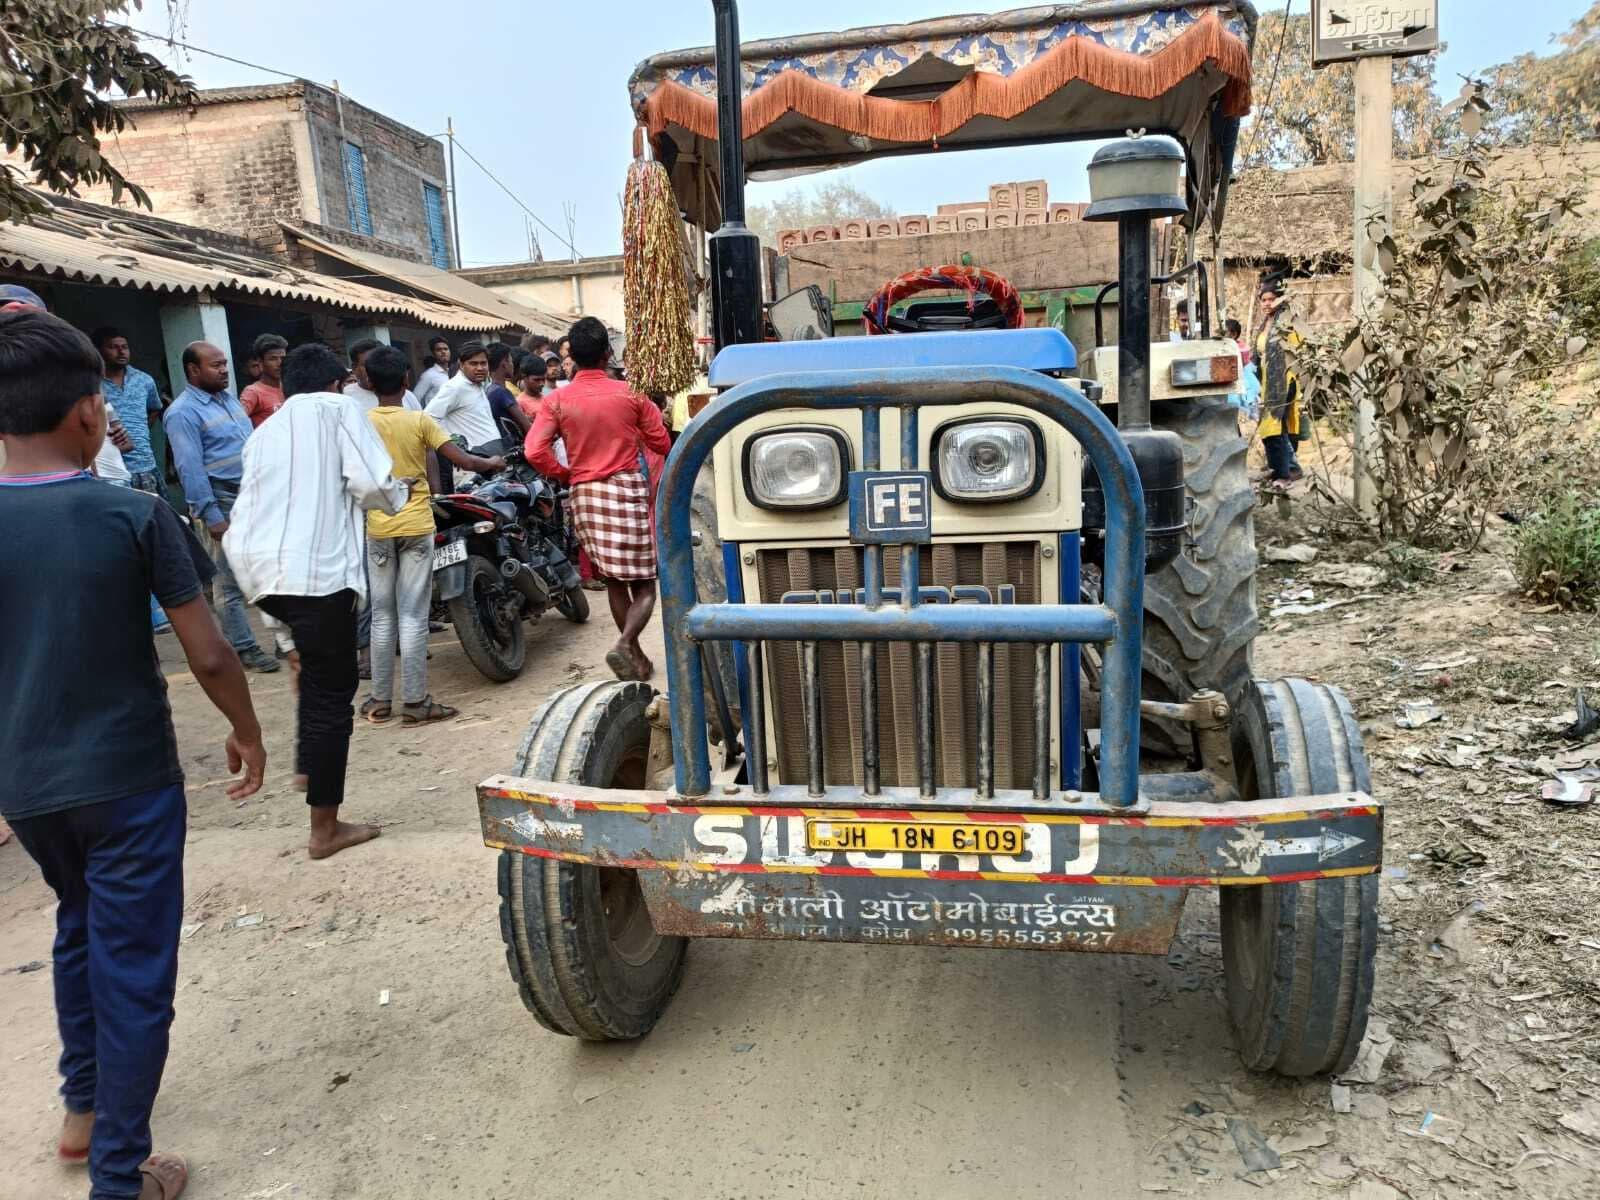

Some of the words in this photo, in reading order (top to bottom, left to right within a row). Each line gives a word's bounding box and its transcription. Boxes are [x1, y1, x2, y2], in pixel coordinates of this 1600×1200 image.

[873, 483, 922, 523] FE
[837, 827, 866, 847] JH
[891, 827, 934, 849] 18N
[952, 829, 1016, 850] 6109
